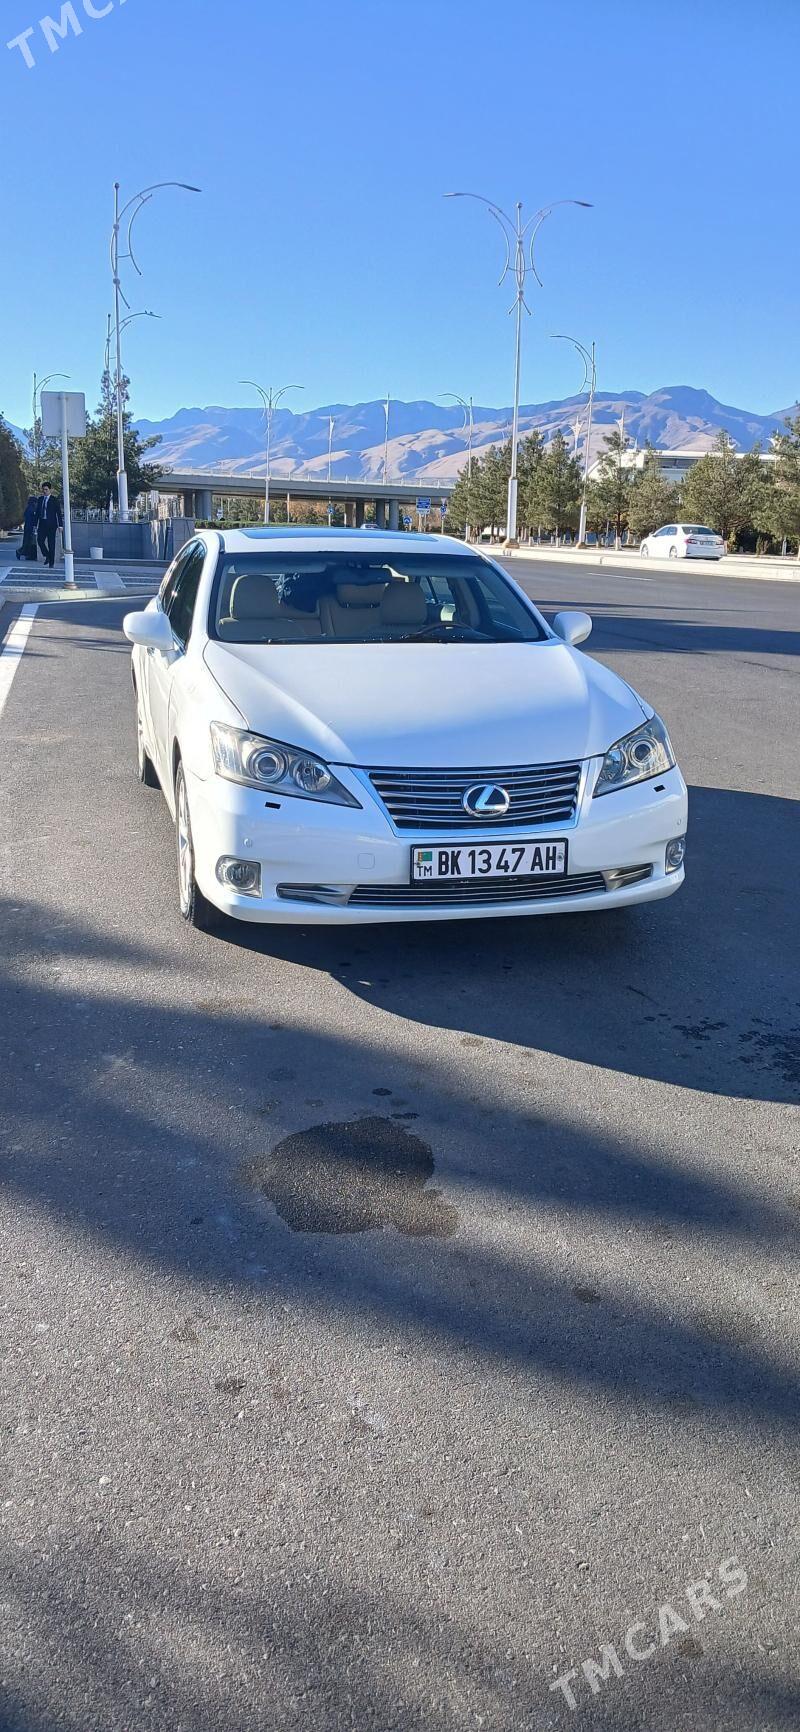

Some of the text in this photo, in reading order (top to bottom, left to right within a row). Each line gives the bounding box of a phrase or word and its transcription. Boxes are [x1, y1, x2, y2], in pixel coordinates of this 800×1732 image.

[438, 850, 462, 876] BK
[530, 846, 557, 872] AH
[416, 866, 433, 877] TM
